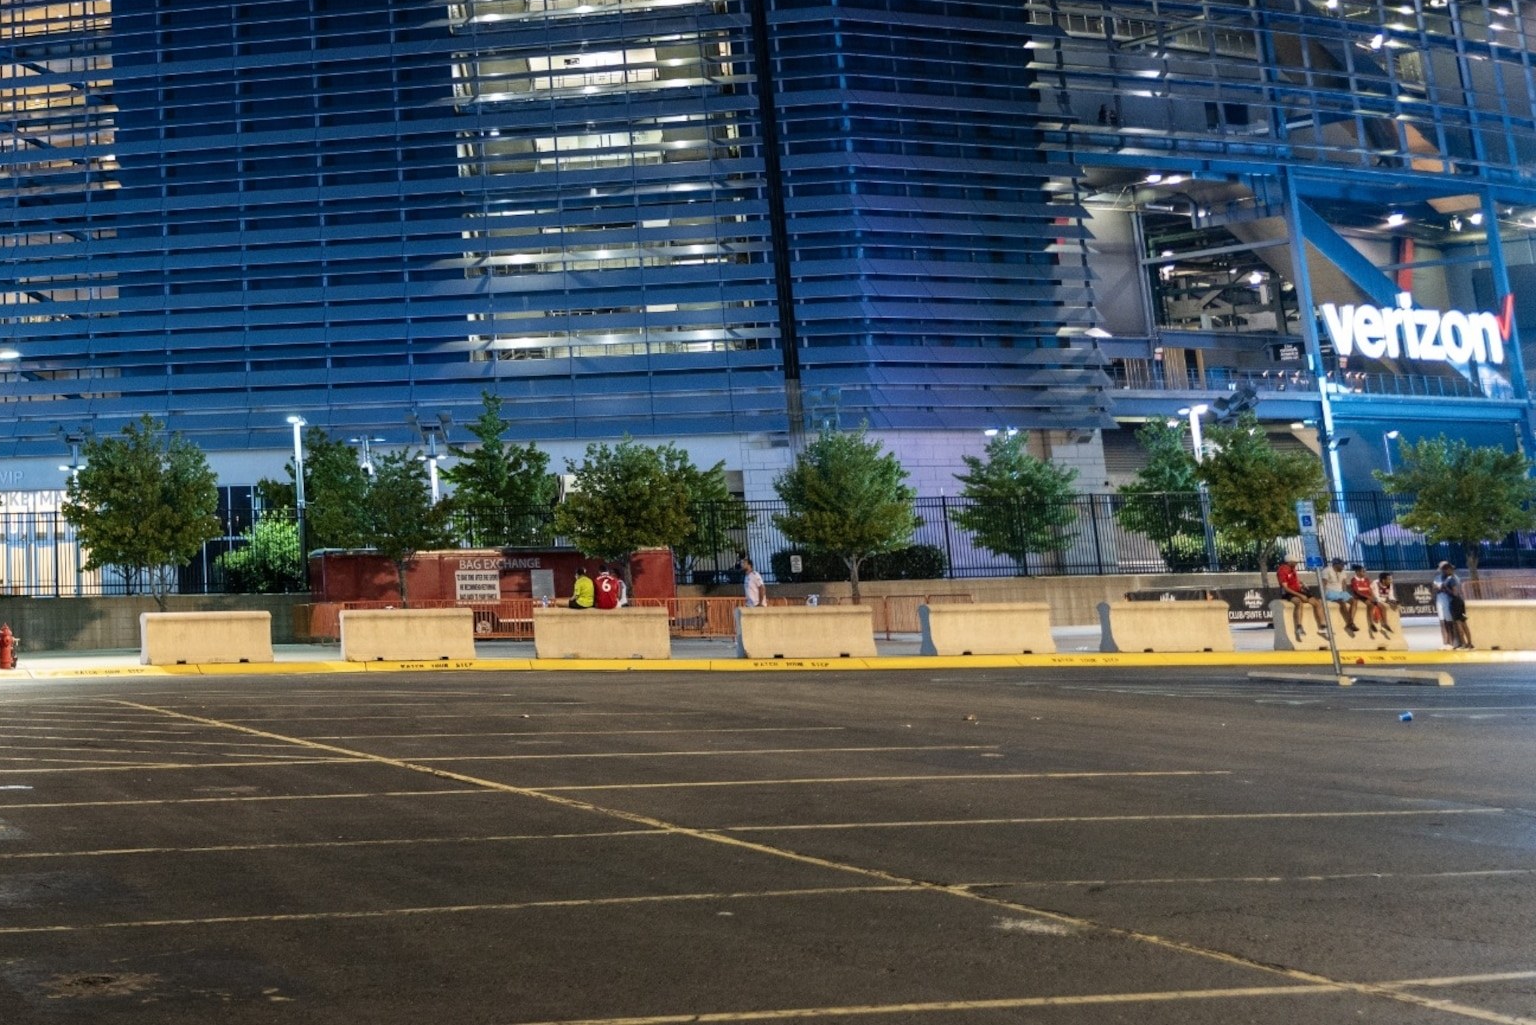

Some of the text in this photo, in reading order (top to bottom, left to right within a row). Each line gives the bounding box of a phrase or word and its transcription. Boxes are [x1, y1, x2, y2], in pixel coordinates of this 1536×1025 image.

[1319, 292, 1504, 364] verizon
[0, 470, 24, 485] VIP
[459, 557, 541, 570] BAG EXCHANGE
[602, 579, 611, 592] 6
